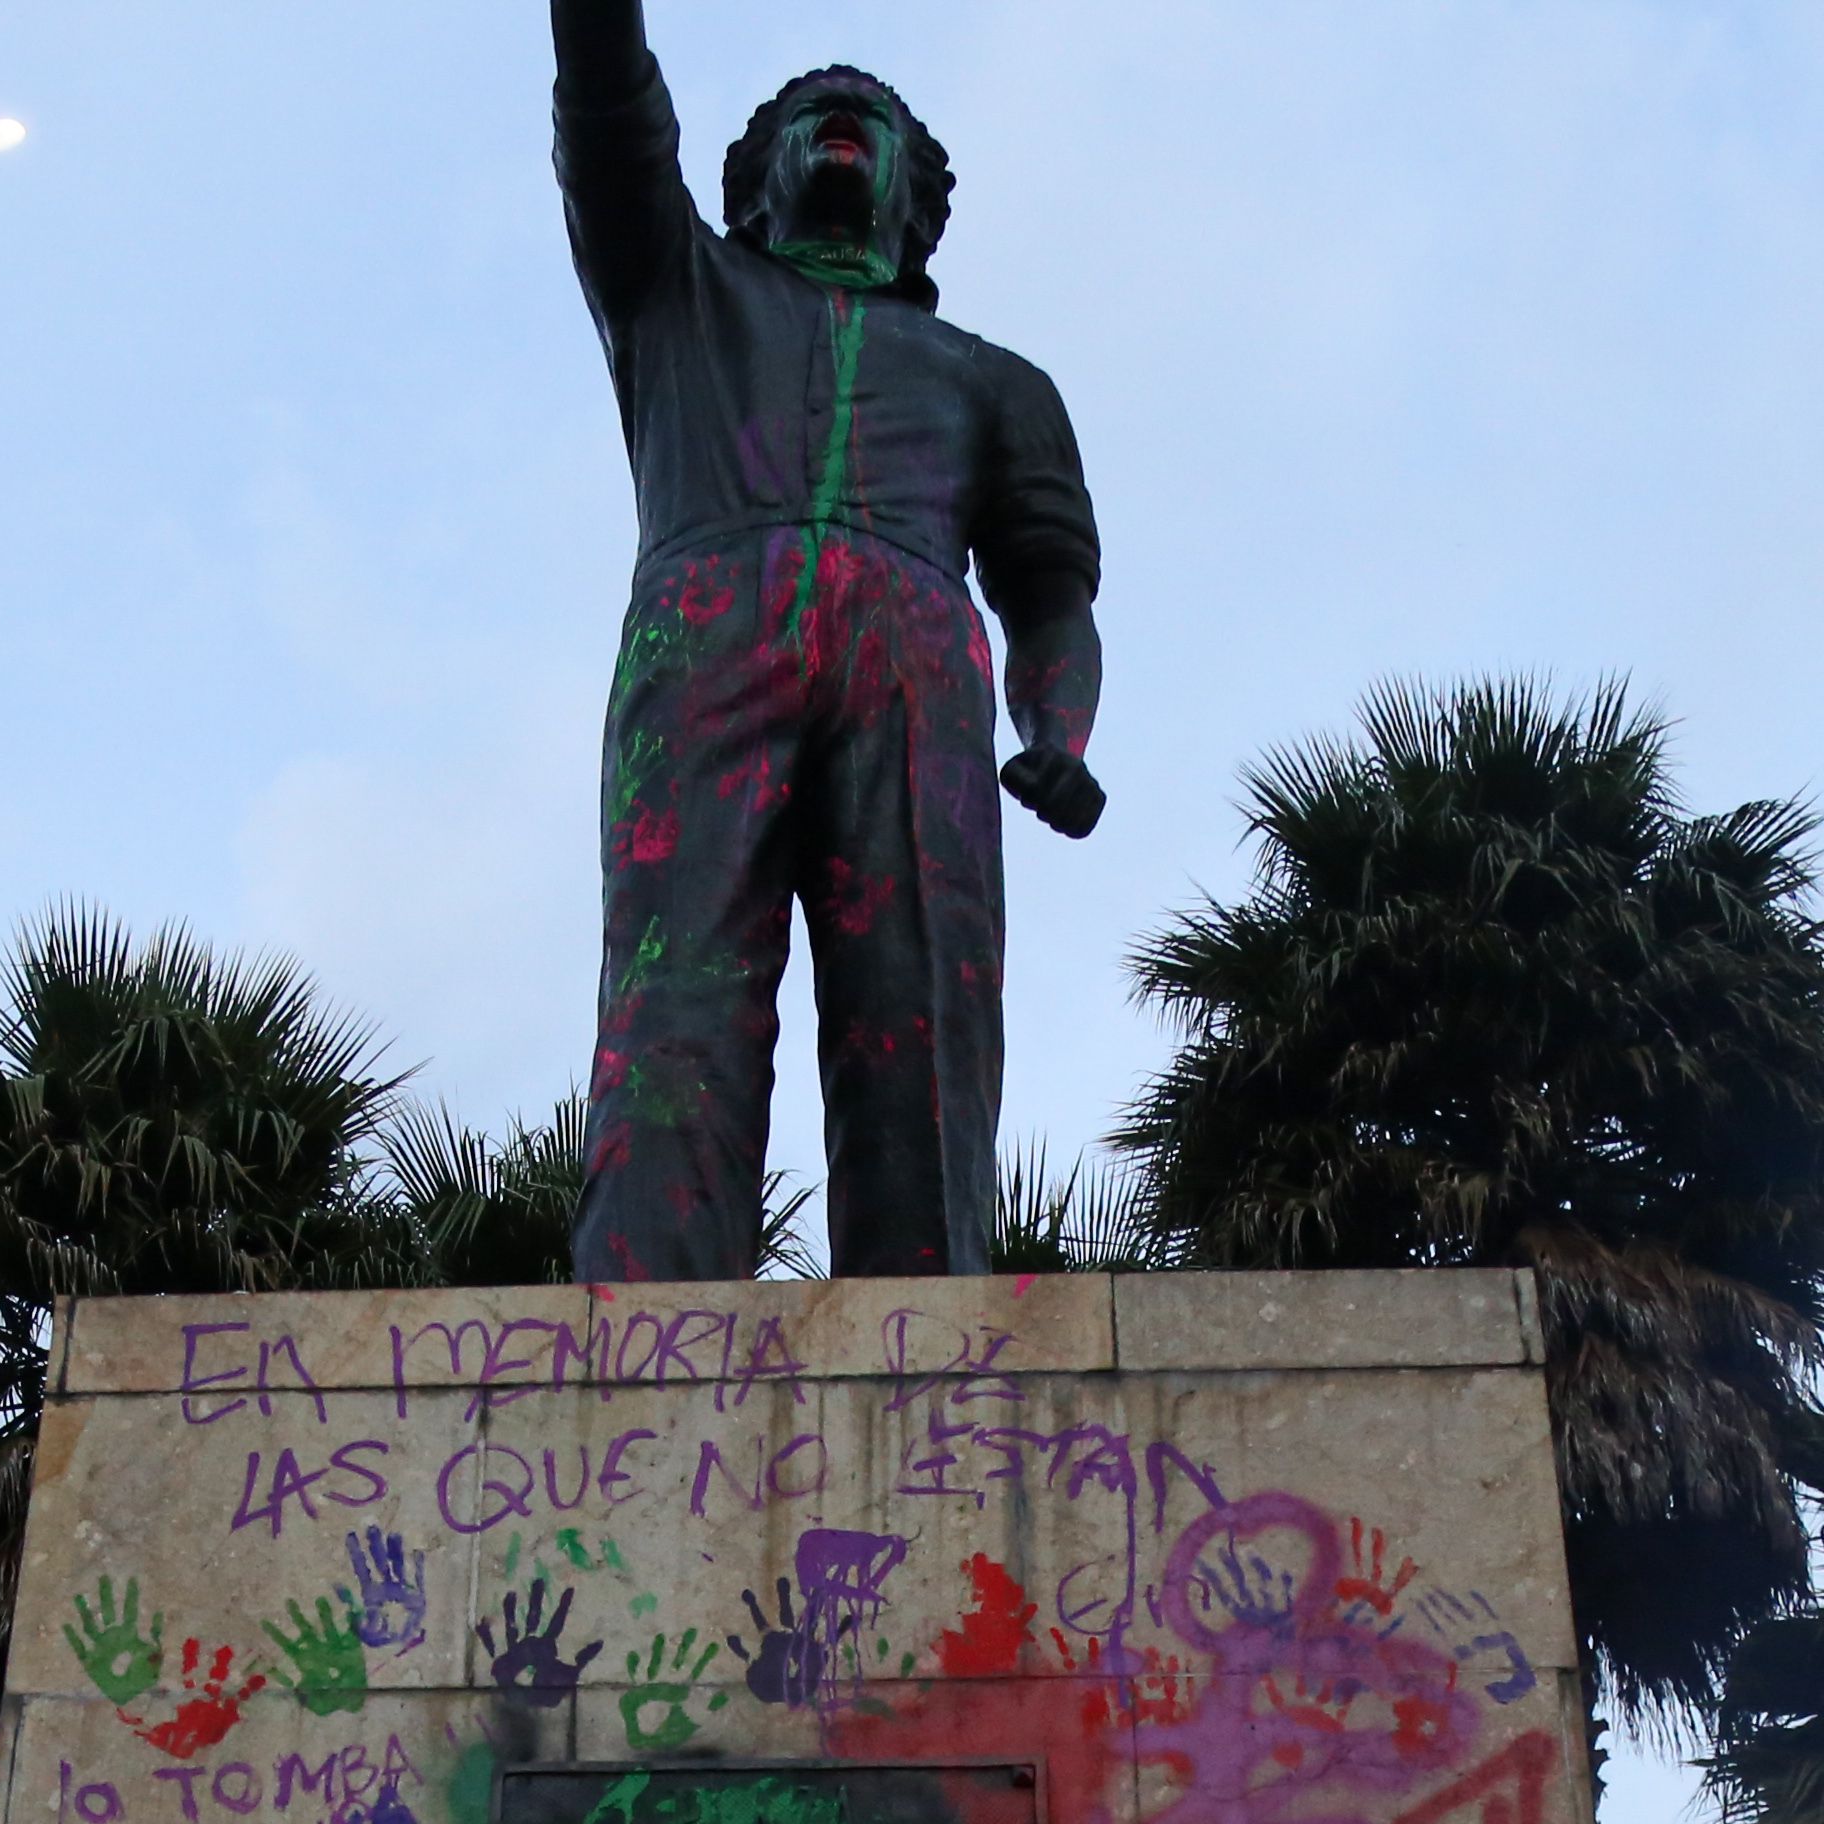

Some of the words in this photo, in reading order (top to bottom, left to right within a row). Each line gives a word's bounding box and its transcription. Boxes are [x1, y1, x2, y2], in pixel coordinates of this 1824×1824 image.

[388, 1309, 809, 1422] MEMORIA
[229, 1440, 389, 1538] LAS
[435, 1428, 658, 1534] QUE
[690, 1432, 828, 1517] NO
